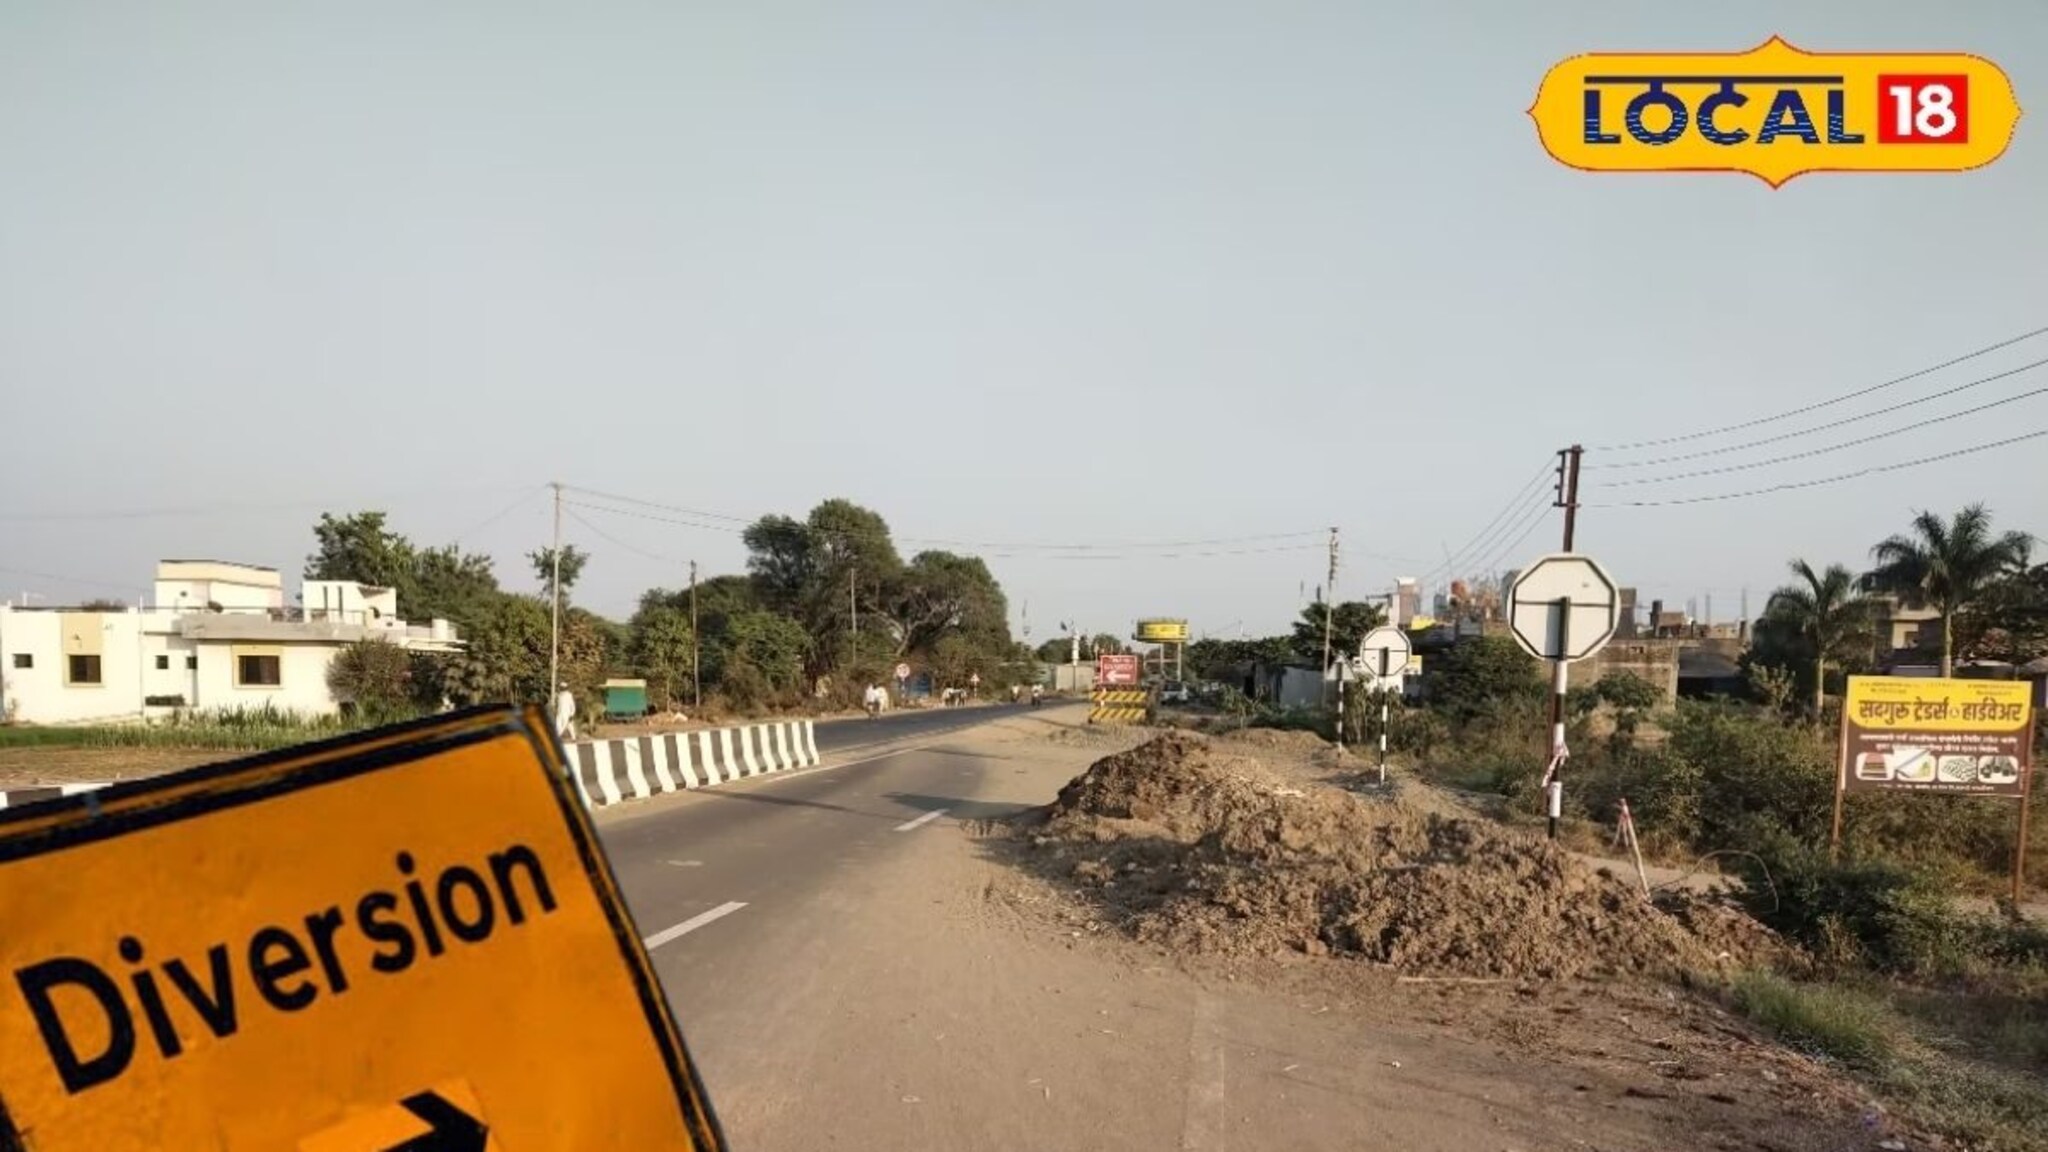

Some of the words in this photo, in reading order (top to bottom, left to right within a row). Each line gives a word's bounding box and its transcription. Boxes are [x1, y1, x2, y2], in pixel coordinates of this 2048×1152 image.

[1913, 695, 1949, 721] ट्रेडर्स
[1961, 696, 2023, 722] हार्डवेअर
[14, 844, 557, 1095] Diversion
